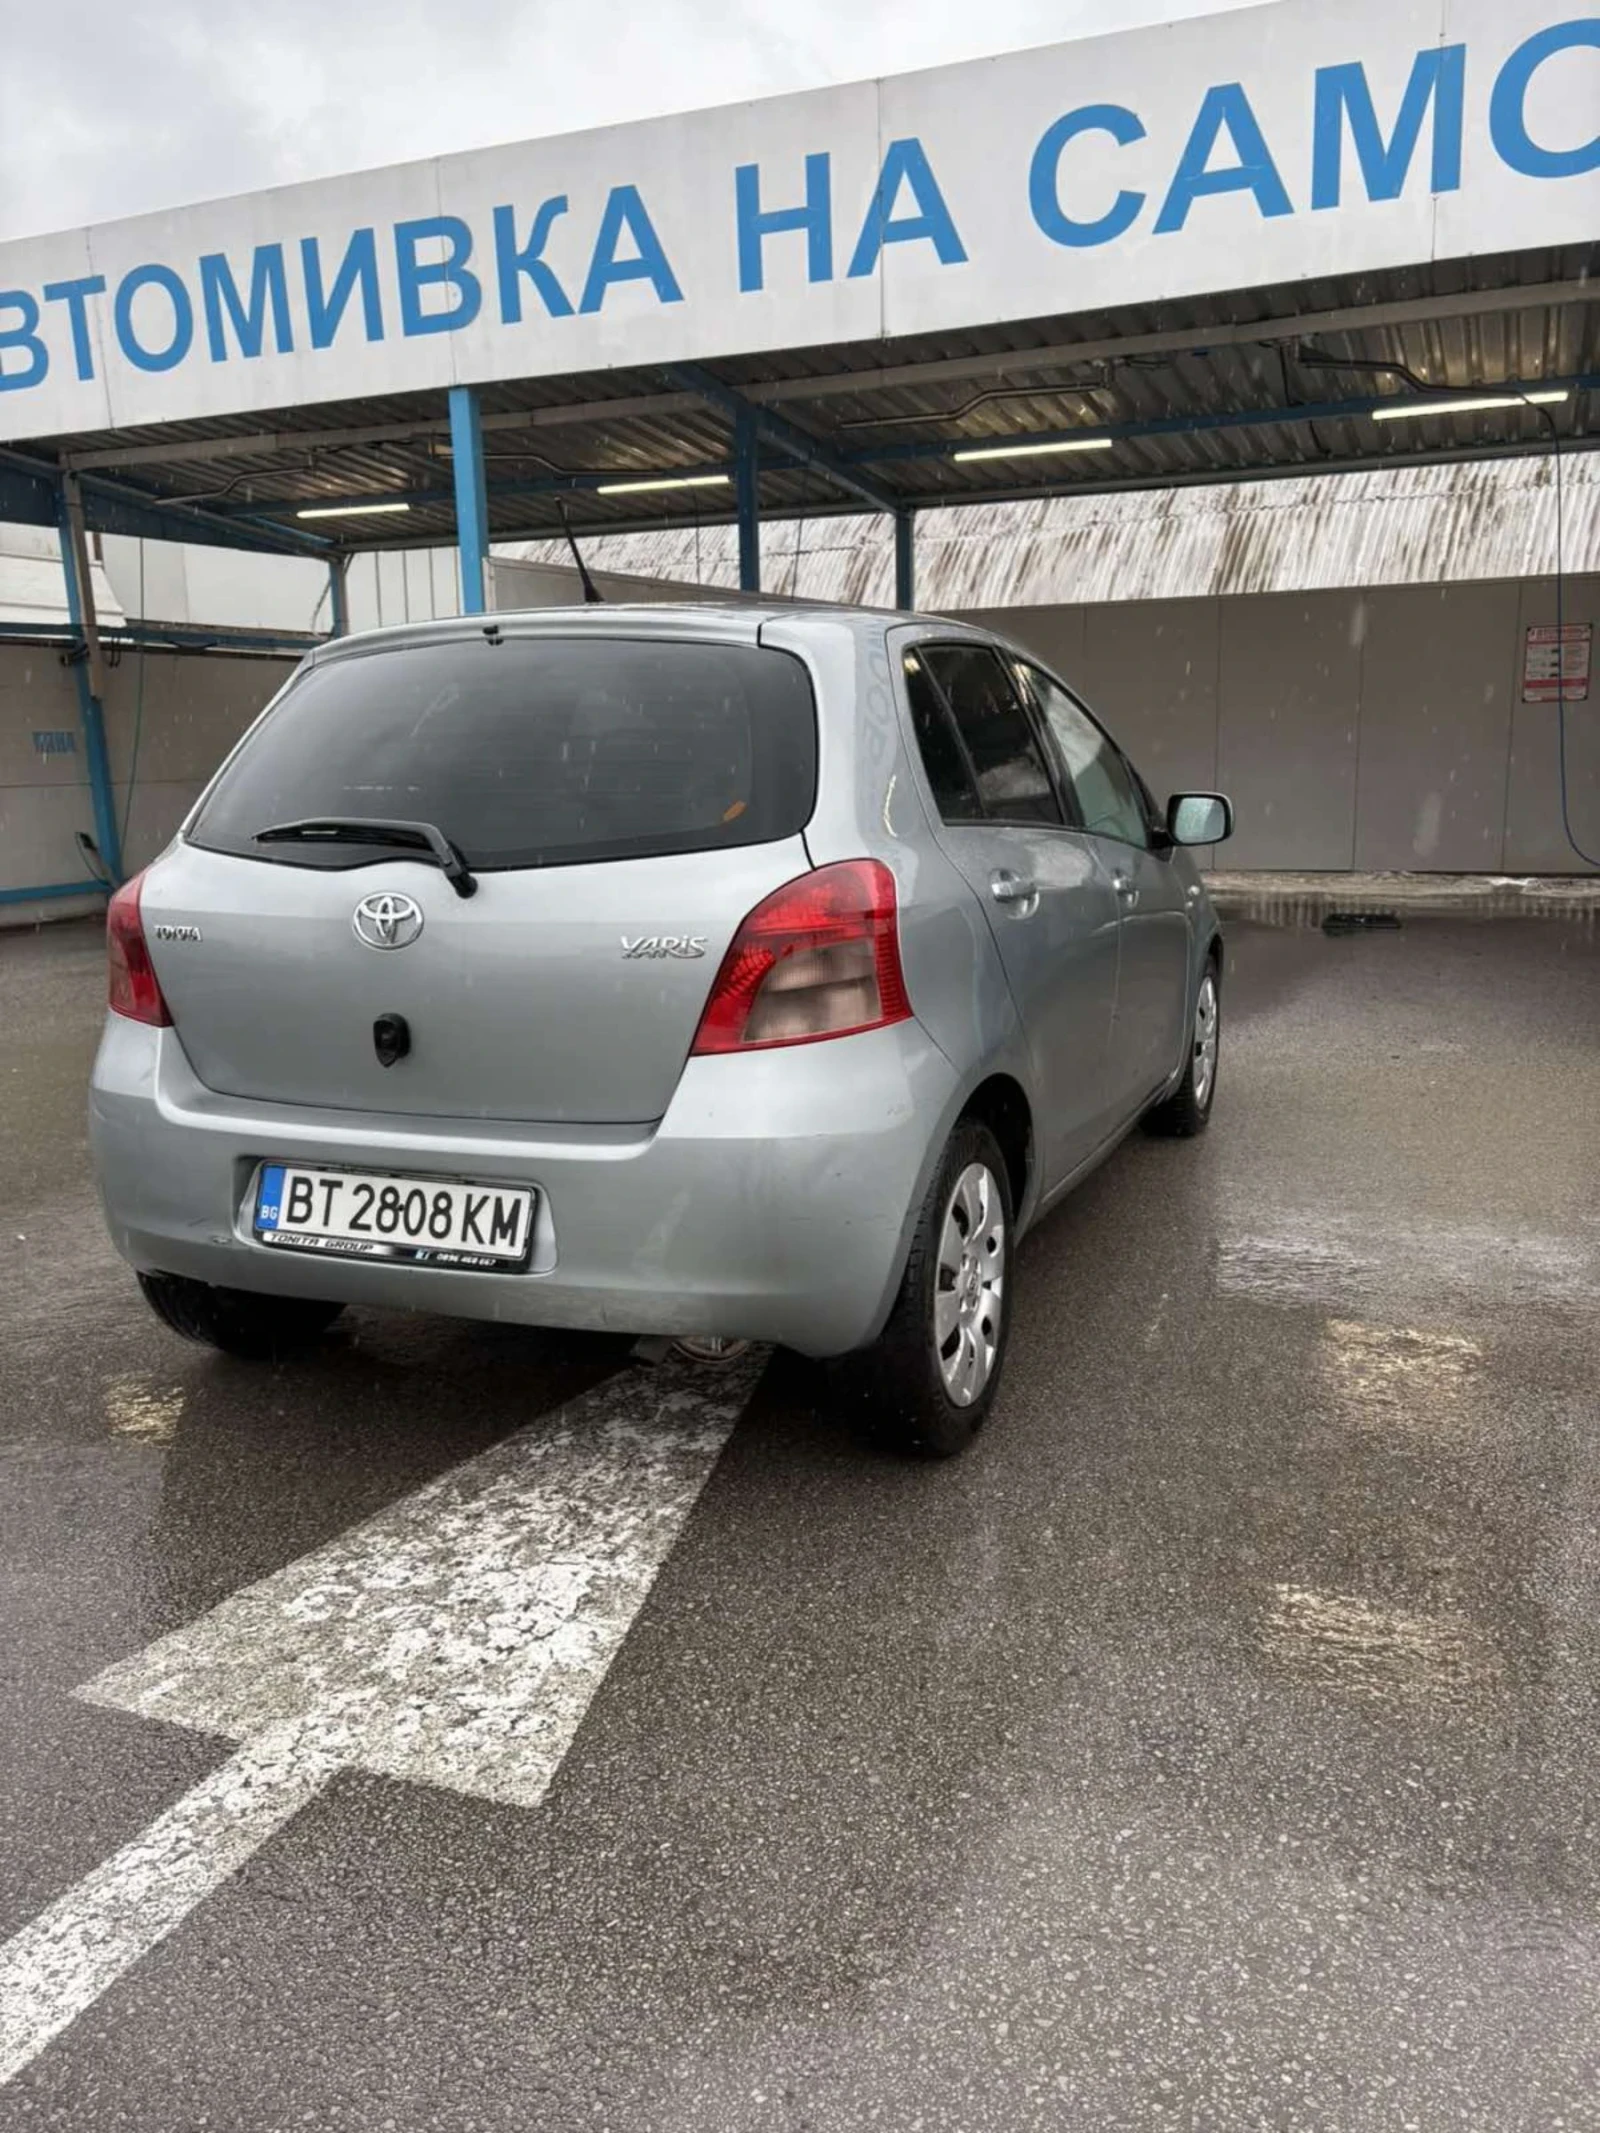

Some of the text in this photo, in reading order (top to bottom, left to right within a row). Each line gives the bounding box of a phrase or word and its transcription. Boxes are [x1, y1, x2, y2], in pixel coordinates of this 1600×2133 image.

[735, 136, 969, 293] НА
[1028, 18, 1600, 248] САМО
[153, 925, 201, 941] TOYOTA
[260, 1204, 279, 1220] BG
[324, 1239, 374, 1252] GROUP
